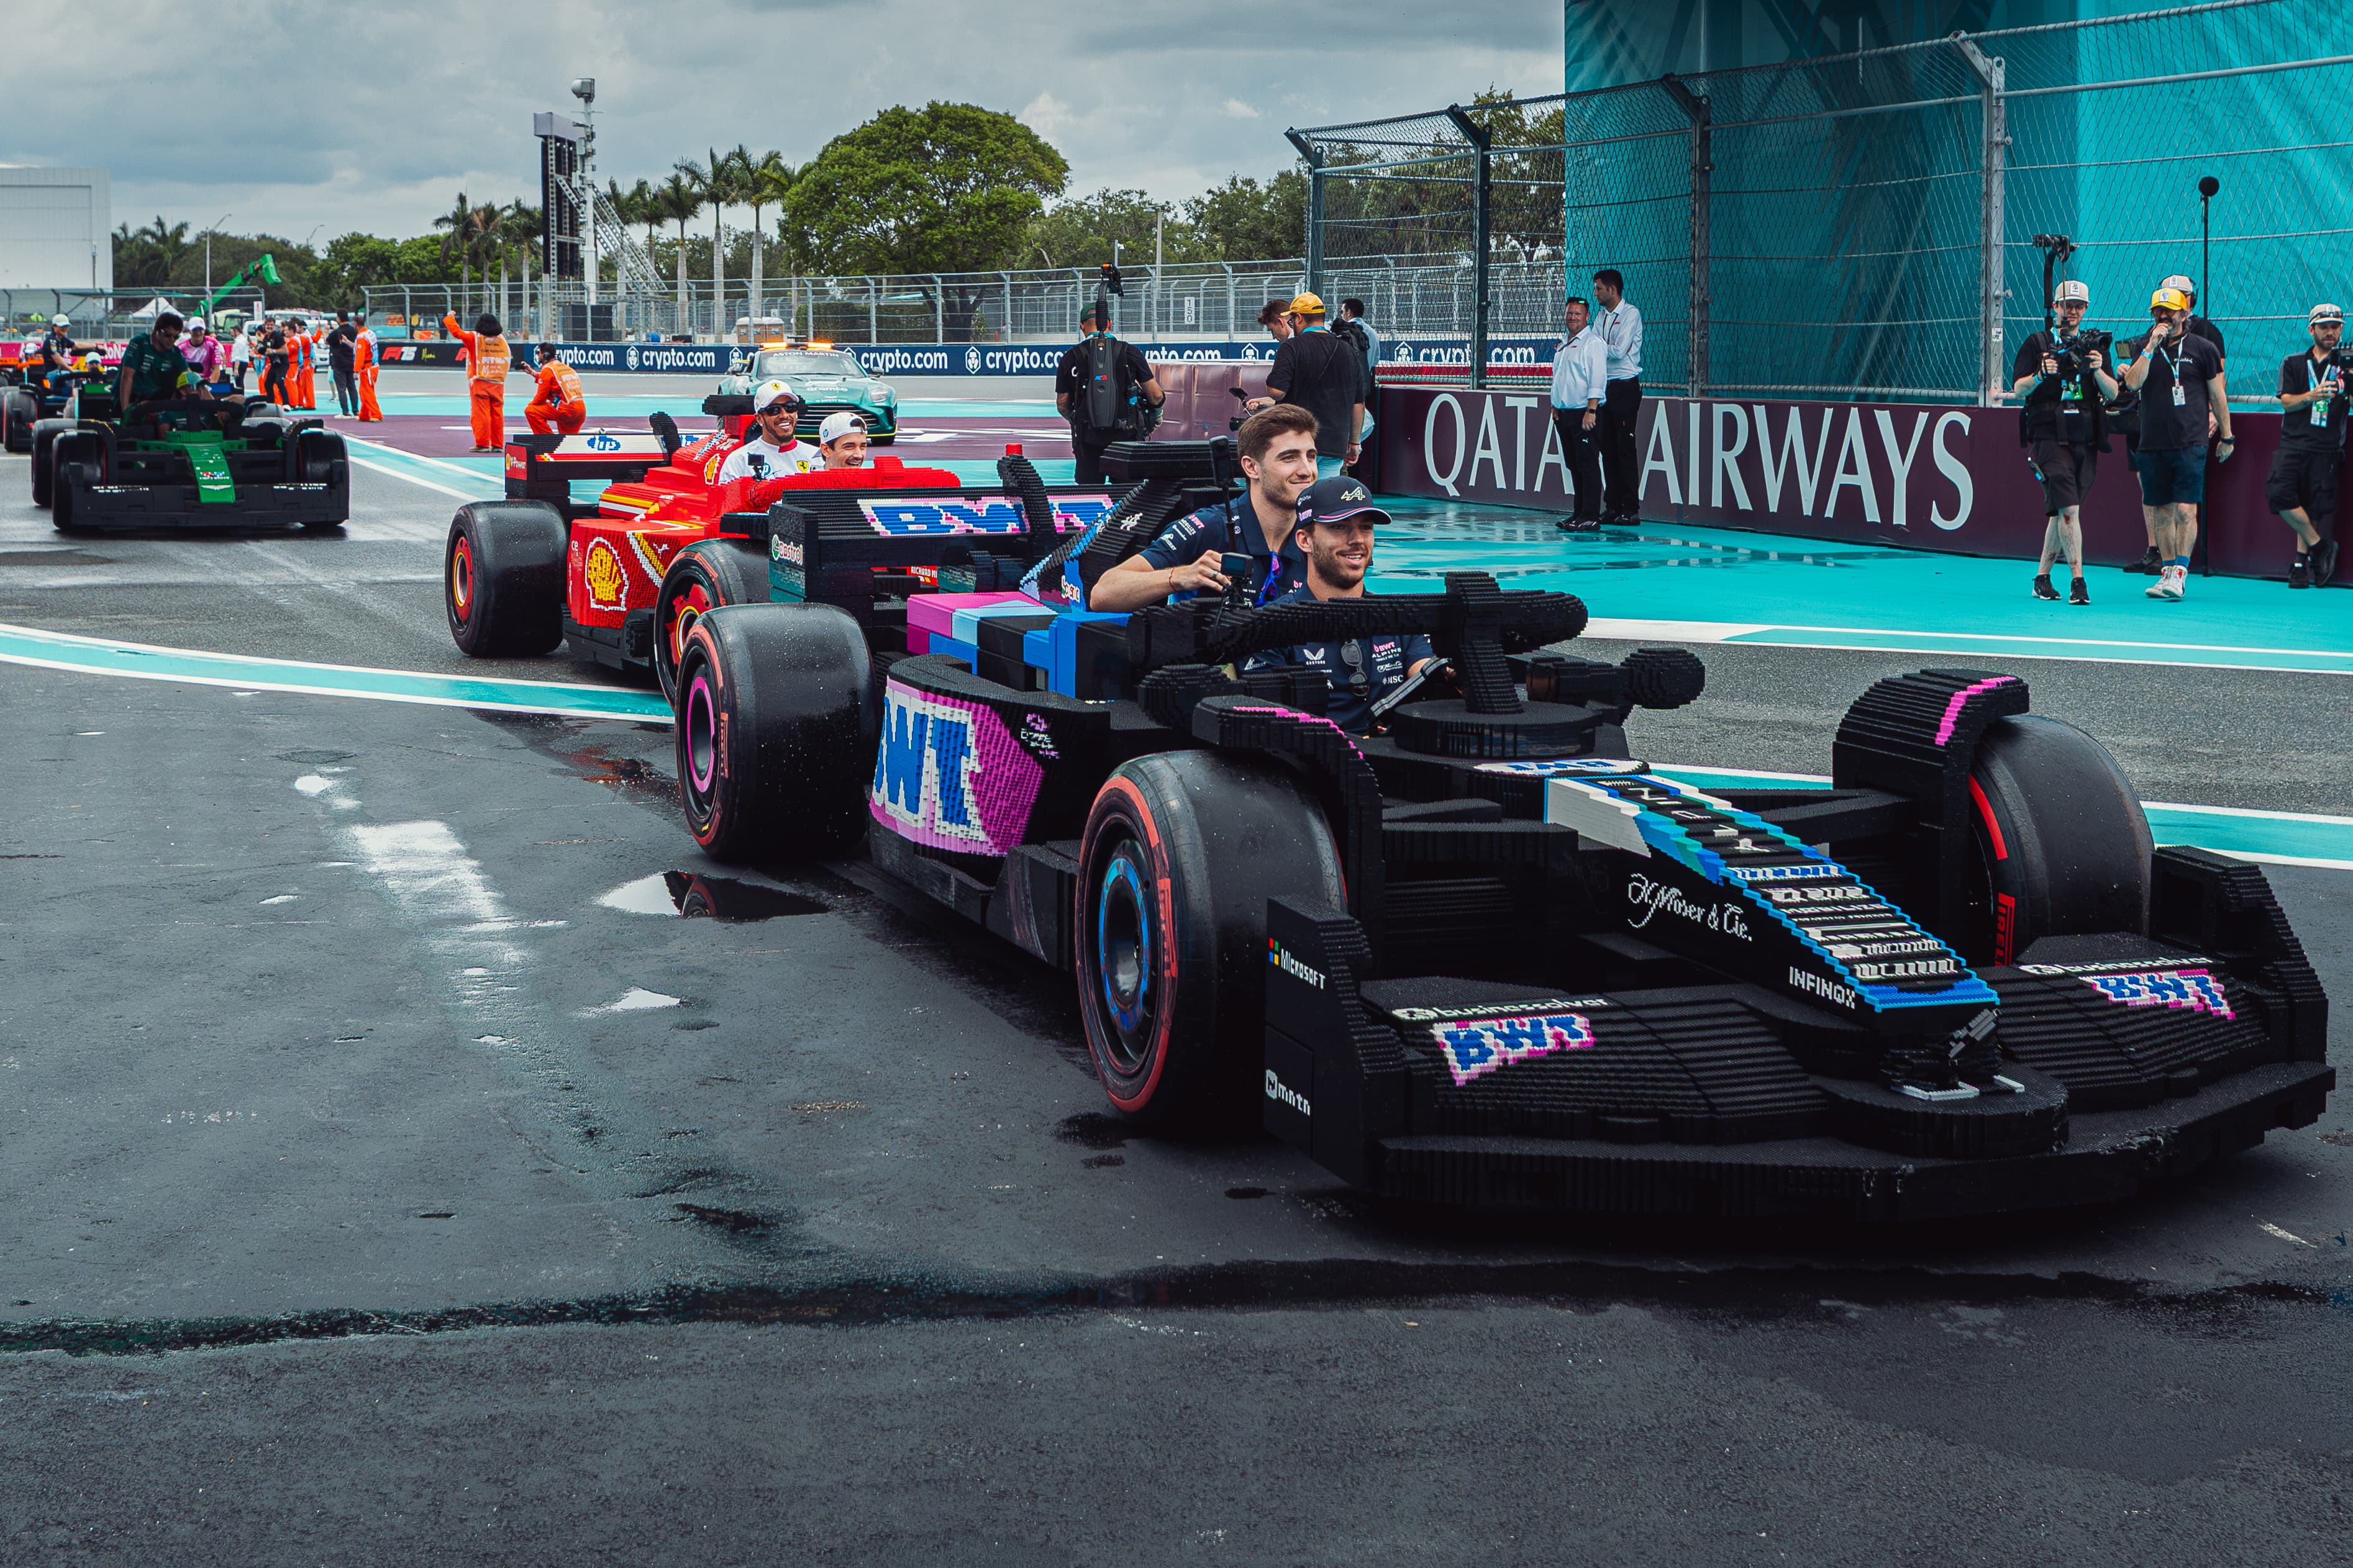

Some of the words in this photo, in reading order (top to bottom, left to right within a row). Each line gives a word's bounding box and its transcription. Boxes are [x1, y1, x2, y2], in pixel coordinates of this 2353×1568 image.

[555, 347, 614, 367] rypto.com
[642, 348, 716, 370] crypto.com
[861, 348, 948, 373] crypto.com
[985, 347, 1064, 373] crypto.co
[1424, 392, 1609, 497] QATA
[1637, 399, 1974, 530] AIRWAYS
[771, 534, 803, 566] Castrol
[1708, 903, 1719, 930] &
[1994, 892, 2016, 966] PIREL
[1789, 966, 1856, 1009] INFINOX
[1430, 1013, 1597, 1087] BWT
